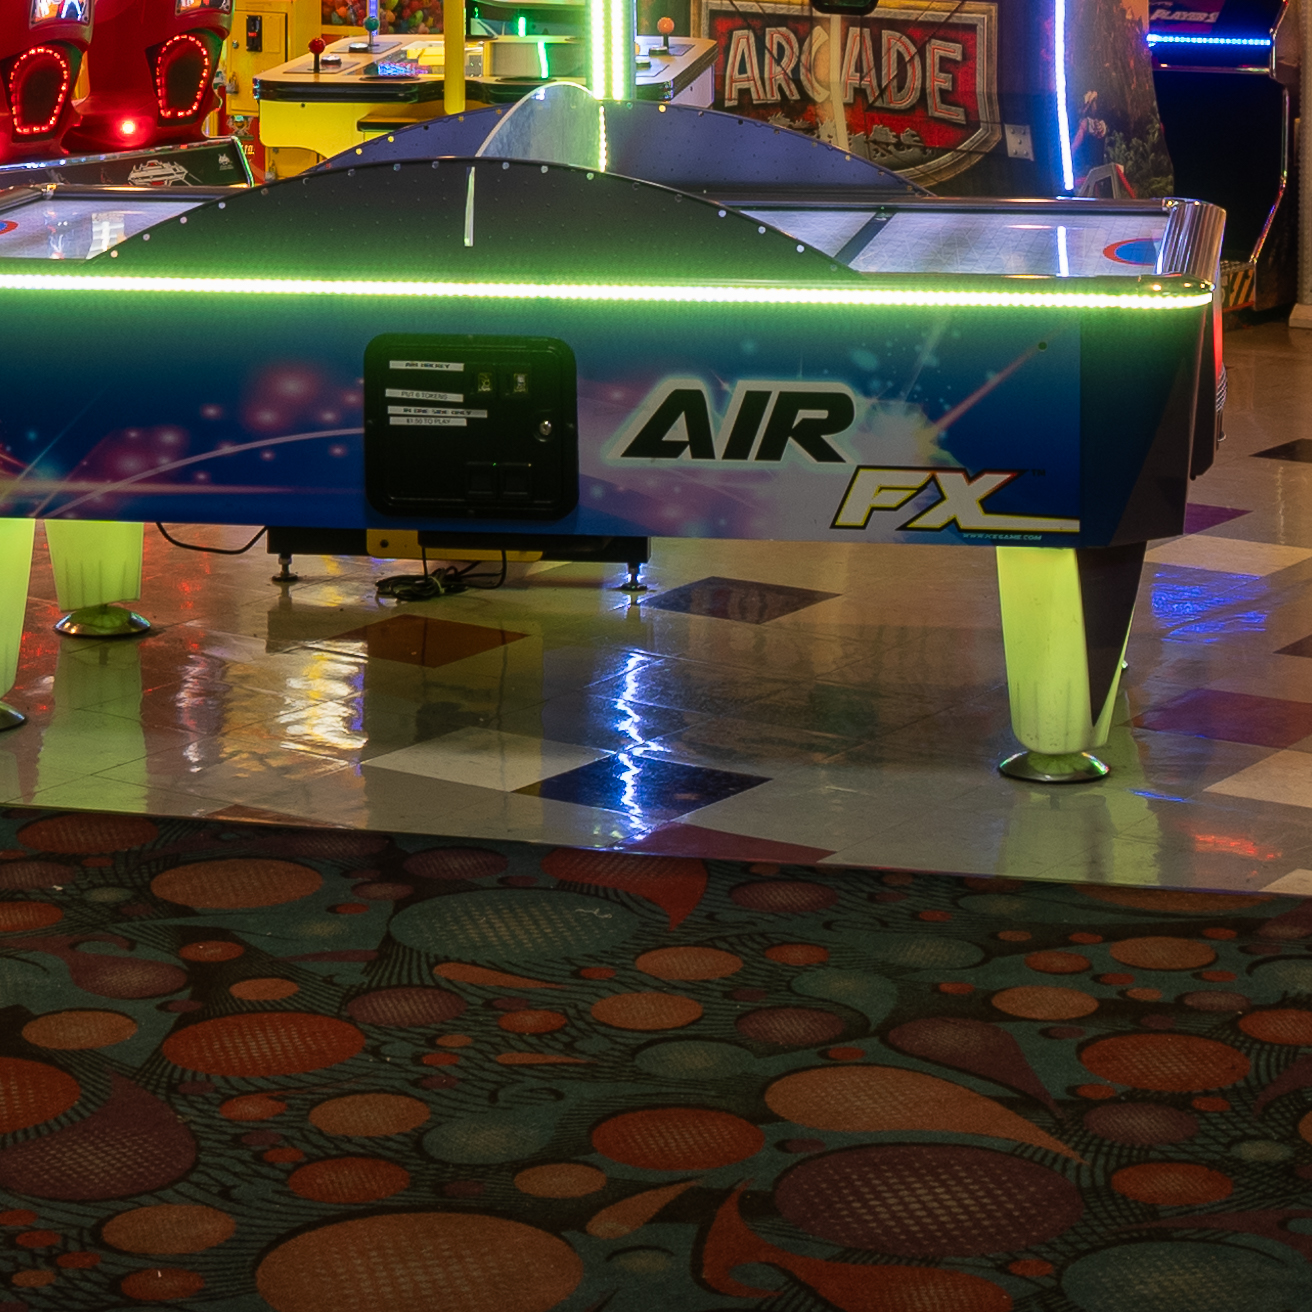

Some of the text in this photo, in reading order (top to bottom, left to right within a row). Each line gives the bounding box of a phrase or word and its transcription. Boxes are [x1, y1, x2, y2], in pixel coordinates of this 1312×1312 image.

[724, 27, 966, 126] ARCADE
[422, 392, 448, 400] TOKENS
[619, 387, 856, 463] AIR
[830, 465, 1081, 534] FX
